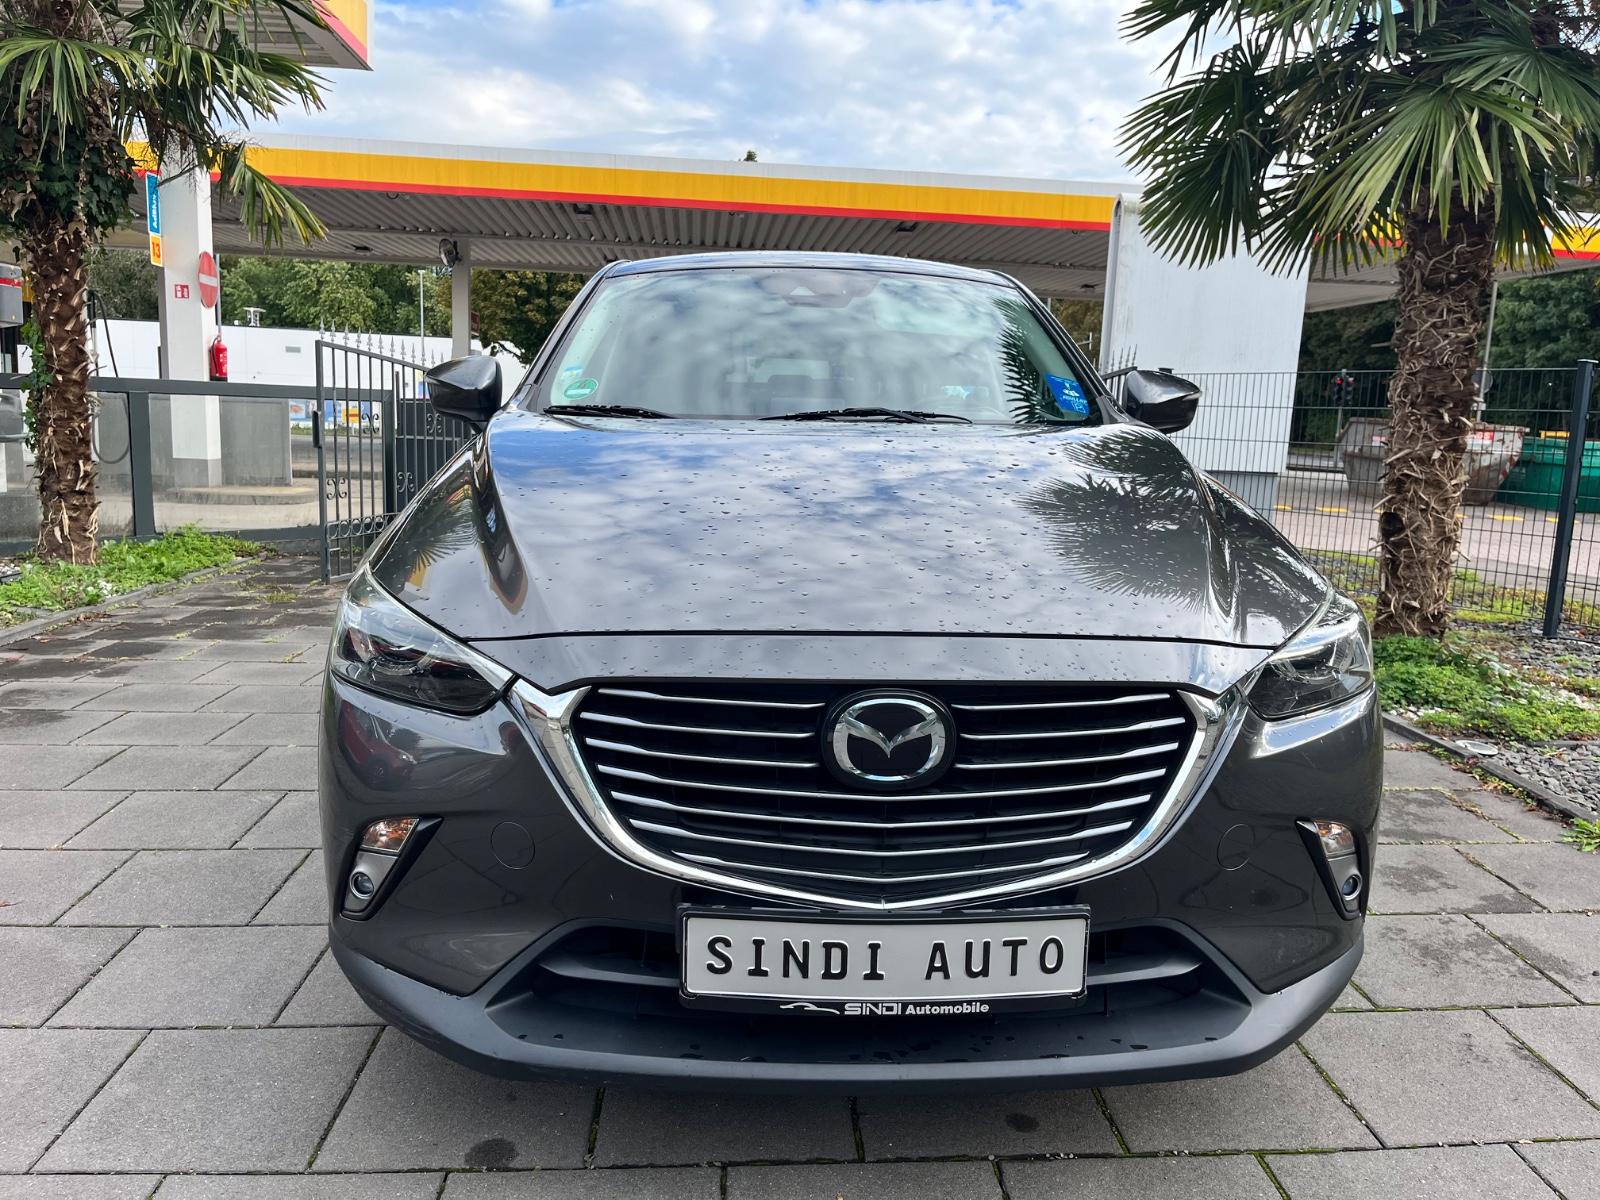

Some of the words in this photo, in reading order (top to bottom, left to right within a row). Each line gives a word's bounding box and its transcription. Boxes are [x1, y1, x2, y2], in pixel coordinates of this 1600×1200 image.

[152, 242, 160, 258] 13
[706, 936, 885, 980] SINDI
[924, 936, 1064, 980] AUTO
[844, 1002, 902, 1015] SINDI
[905, 1002, 990, 1015] Automobile
